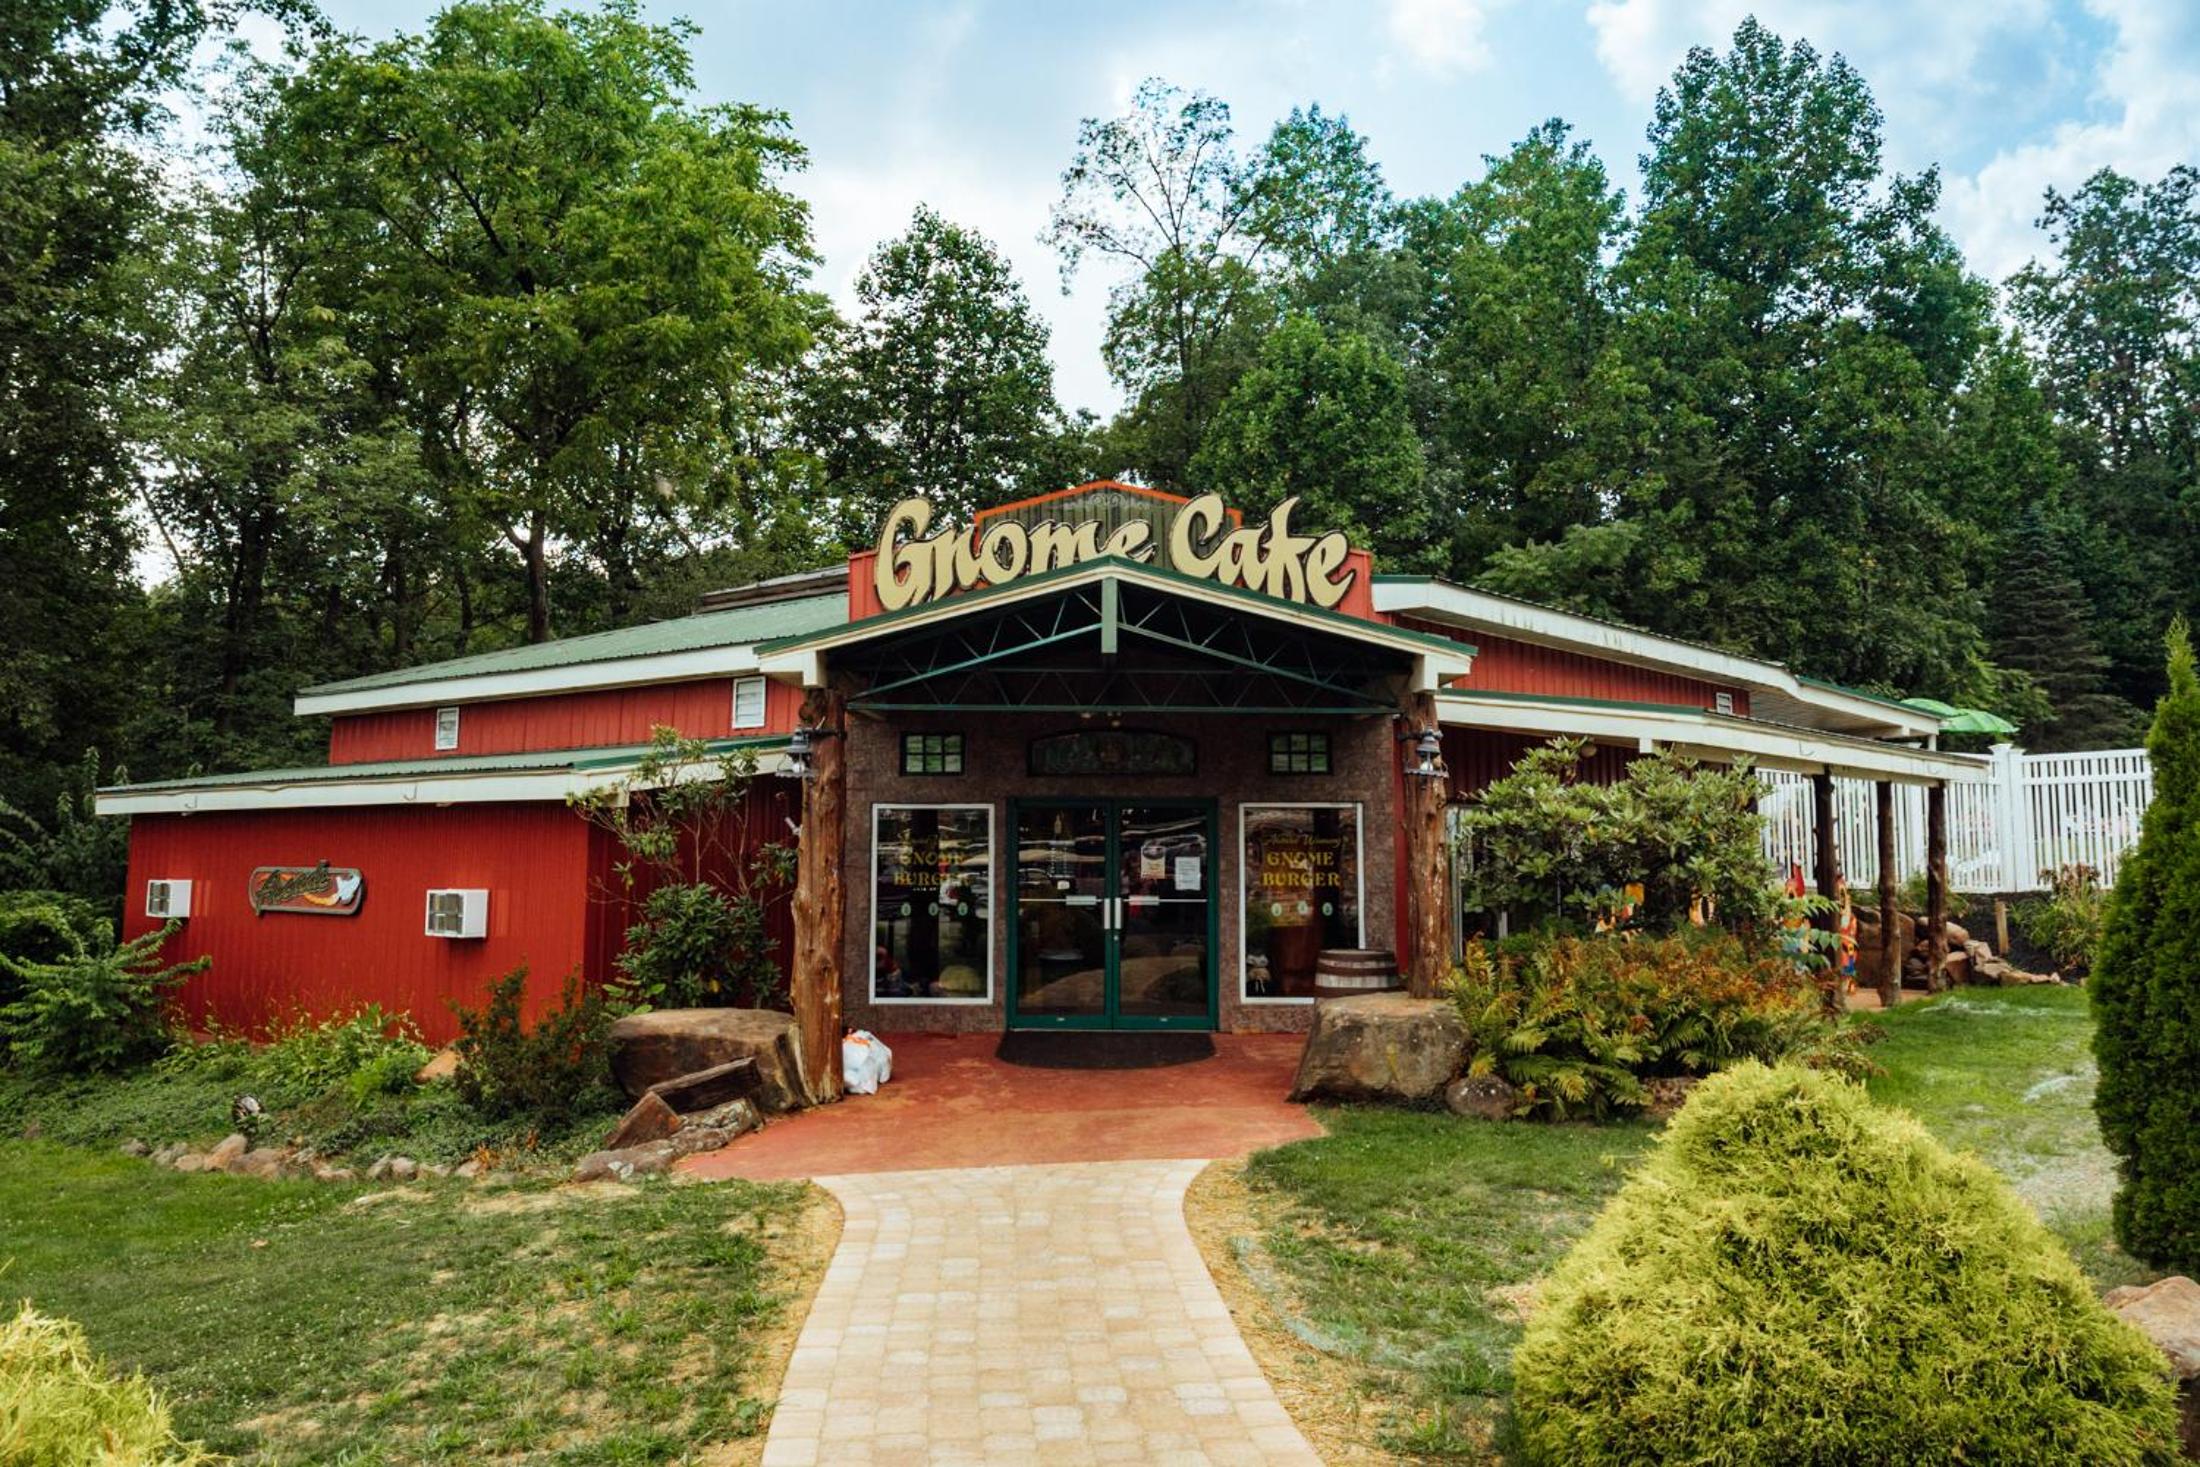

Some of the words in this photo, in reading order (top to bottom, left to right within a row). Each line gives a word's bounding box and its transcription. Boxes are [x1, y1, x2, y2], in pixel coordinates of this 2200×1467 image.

[874, 495, 1157, 611] Gnome
[1267, 851, 1335, 867] GNOME
[1263, 871, 1341, 887] BURGER
